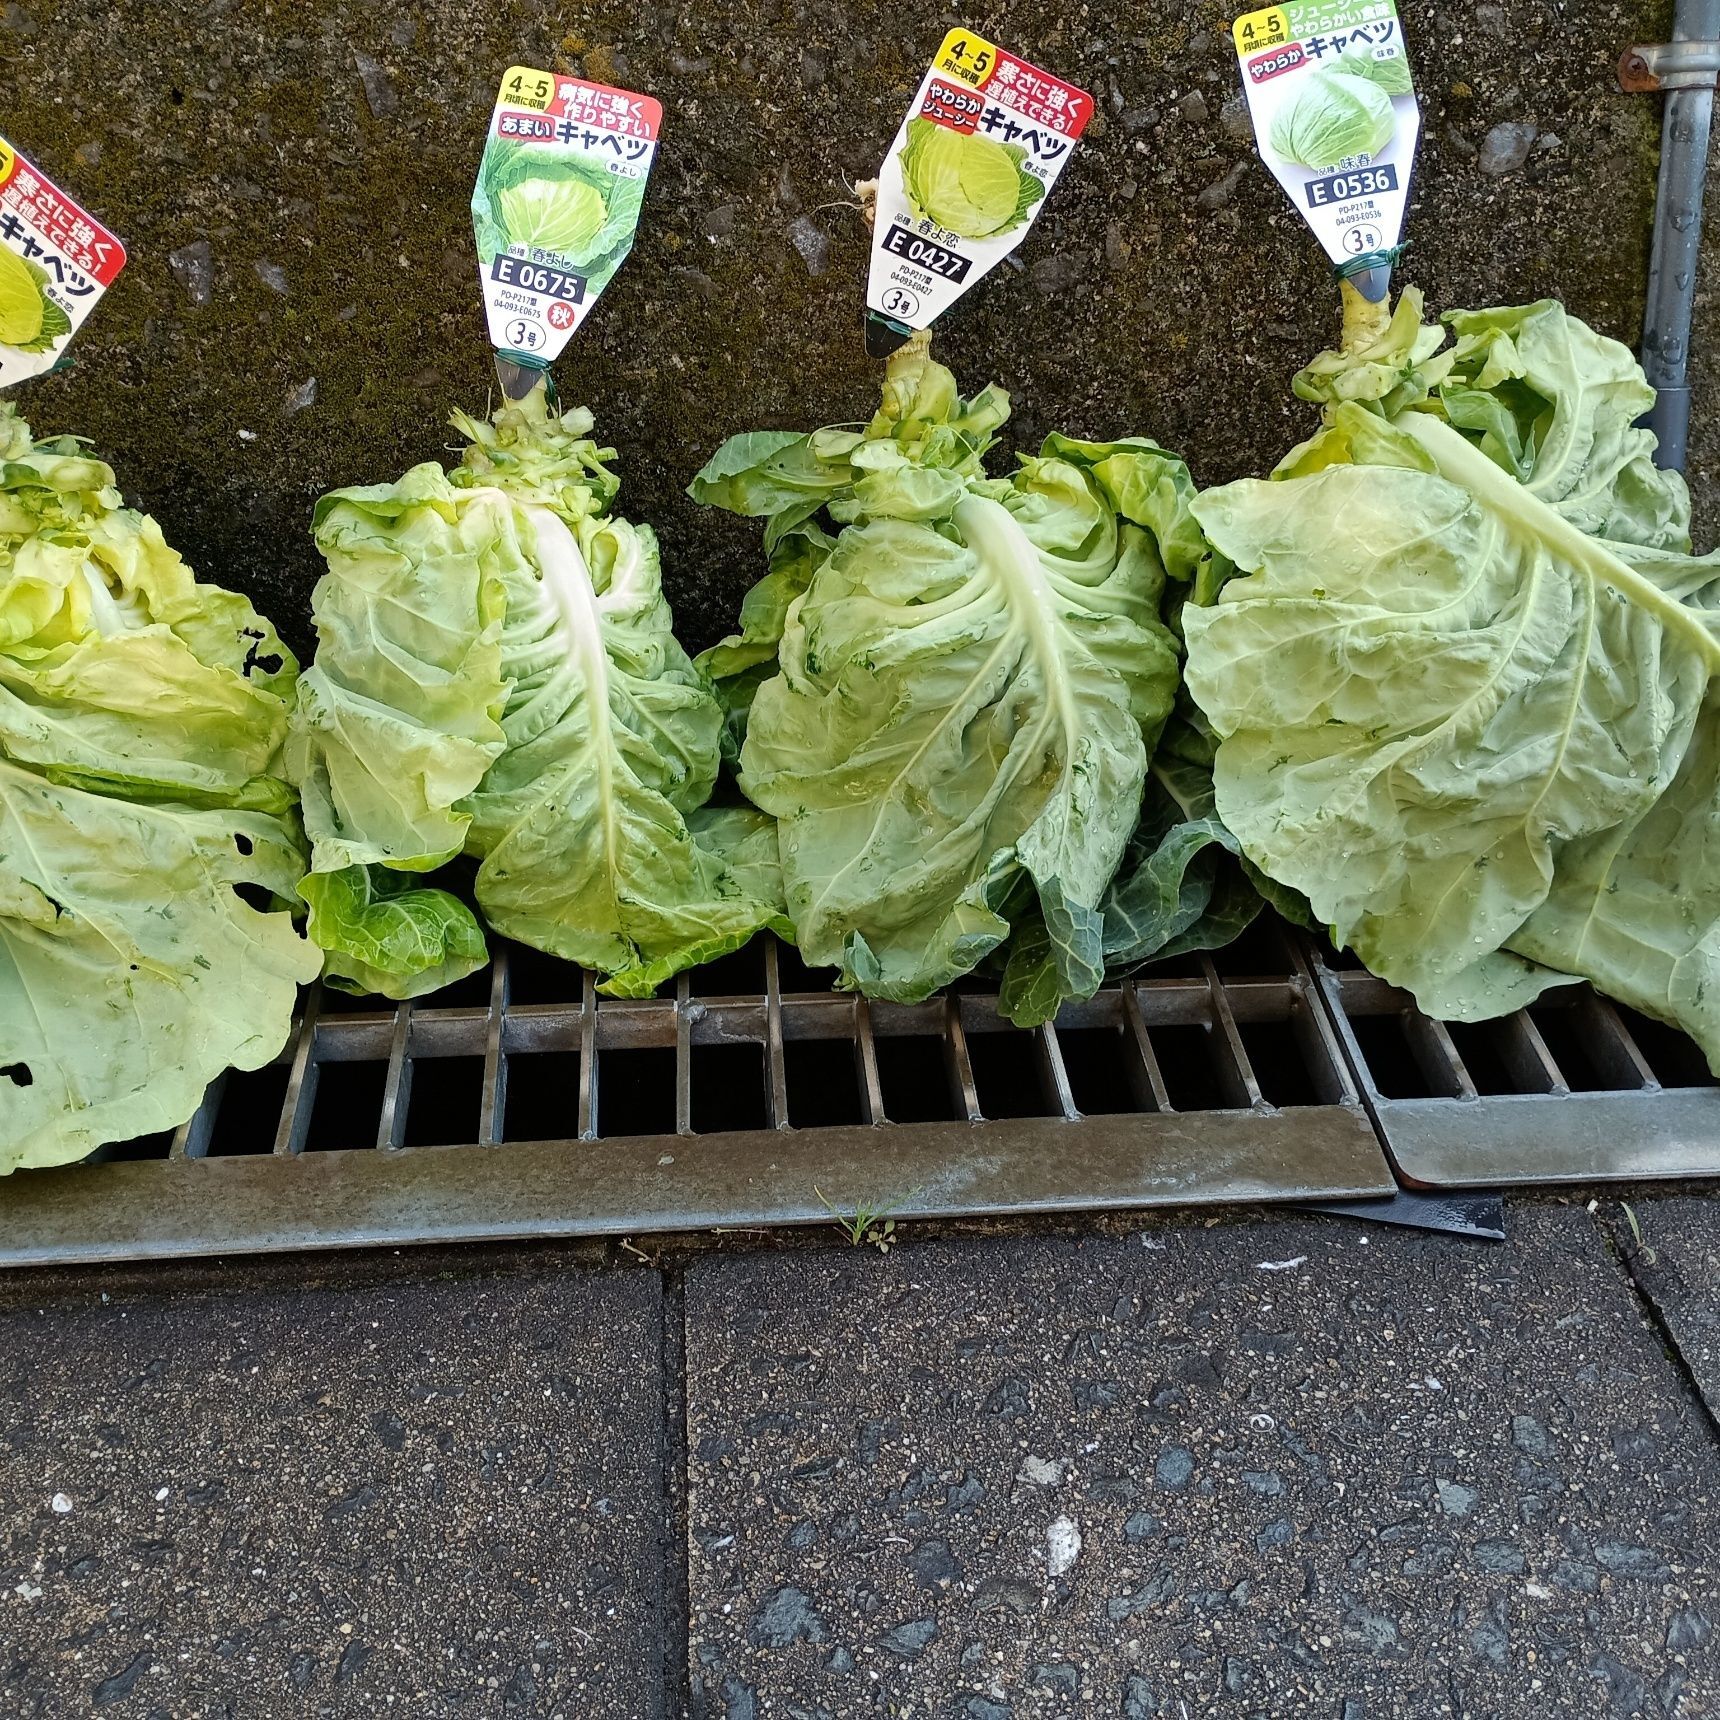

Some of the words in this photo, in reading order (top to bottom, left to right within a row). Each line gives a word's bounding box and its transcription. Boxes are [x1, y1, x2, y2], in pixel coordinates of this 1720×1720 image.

[1305, 20, 1394, 58] キャベツ
[942, 58, 980, 85] 月に収穫
[1251, 49, 1301, 78] やわらか
[504, 93, 546, 110] 月頃に収穫
[558, 83, 644, 119] 病気に強く
[930, 83, 982, 114] やわらか
[996, 59, 1083, 118] 寒さに強く
[501, 116, 550, 137] あまい
[563, 102, 650, 137] 作りやすい
[922, 101, 975, 128] ジューシー
[556, 121, 648, 160] キャベツ
[980, 107, 1067, 159] キャベツ
[1312, 183, 1327, 204] E
[1333, 169, 1390, 199] 0536
[14, 168, 113, 264] 寒さに強く
[918, 219, 960, 249] 春よ恋
[0, 213, 95, 296] キャベツ
[532, 248, 573, 270] 春よし
[889, 230, 907, 253] E
[908, 240, 963, 277] 0427
[498, 259, 513, 281] E
[520, 266, 577, 299] 0675
[890, 271, 933, 296] 04-093-E0427
[494, 299, 541, 319] 04-093-E0675
[551, 305, 571, 327] 秋
[887, 290, 911, 315] 3号
[514, 322, 536, 346] 3号
